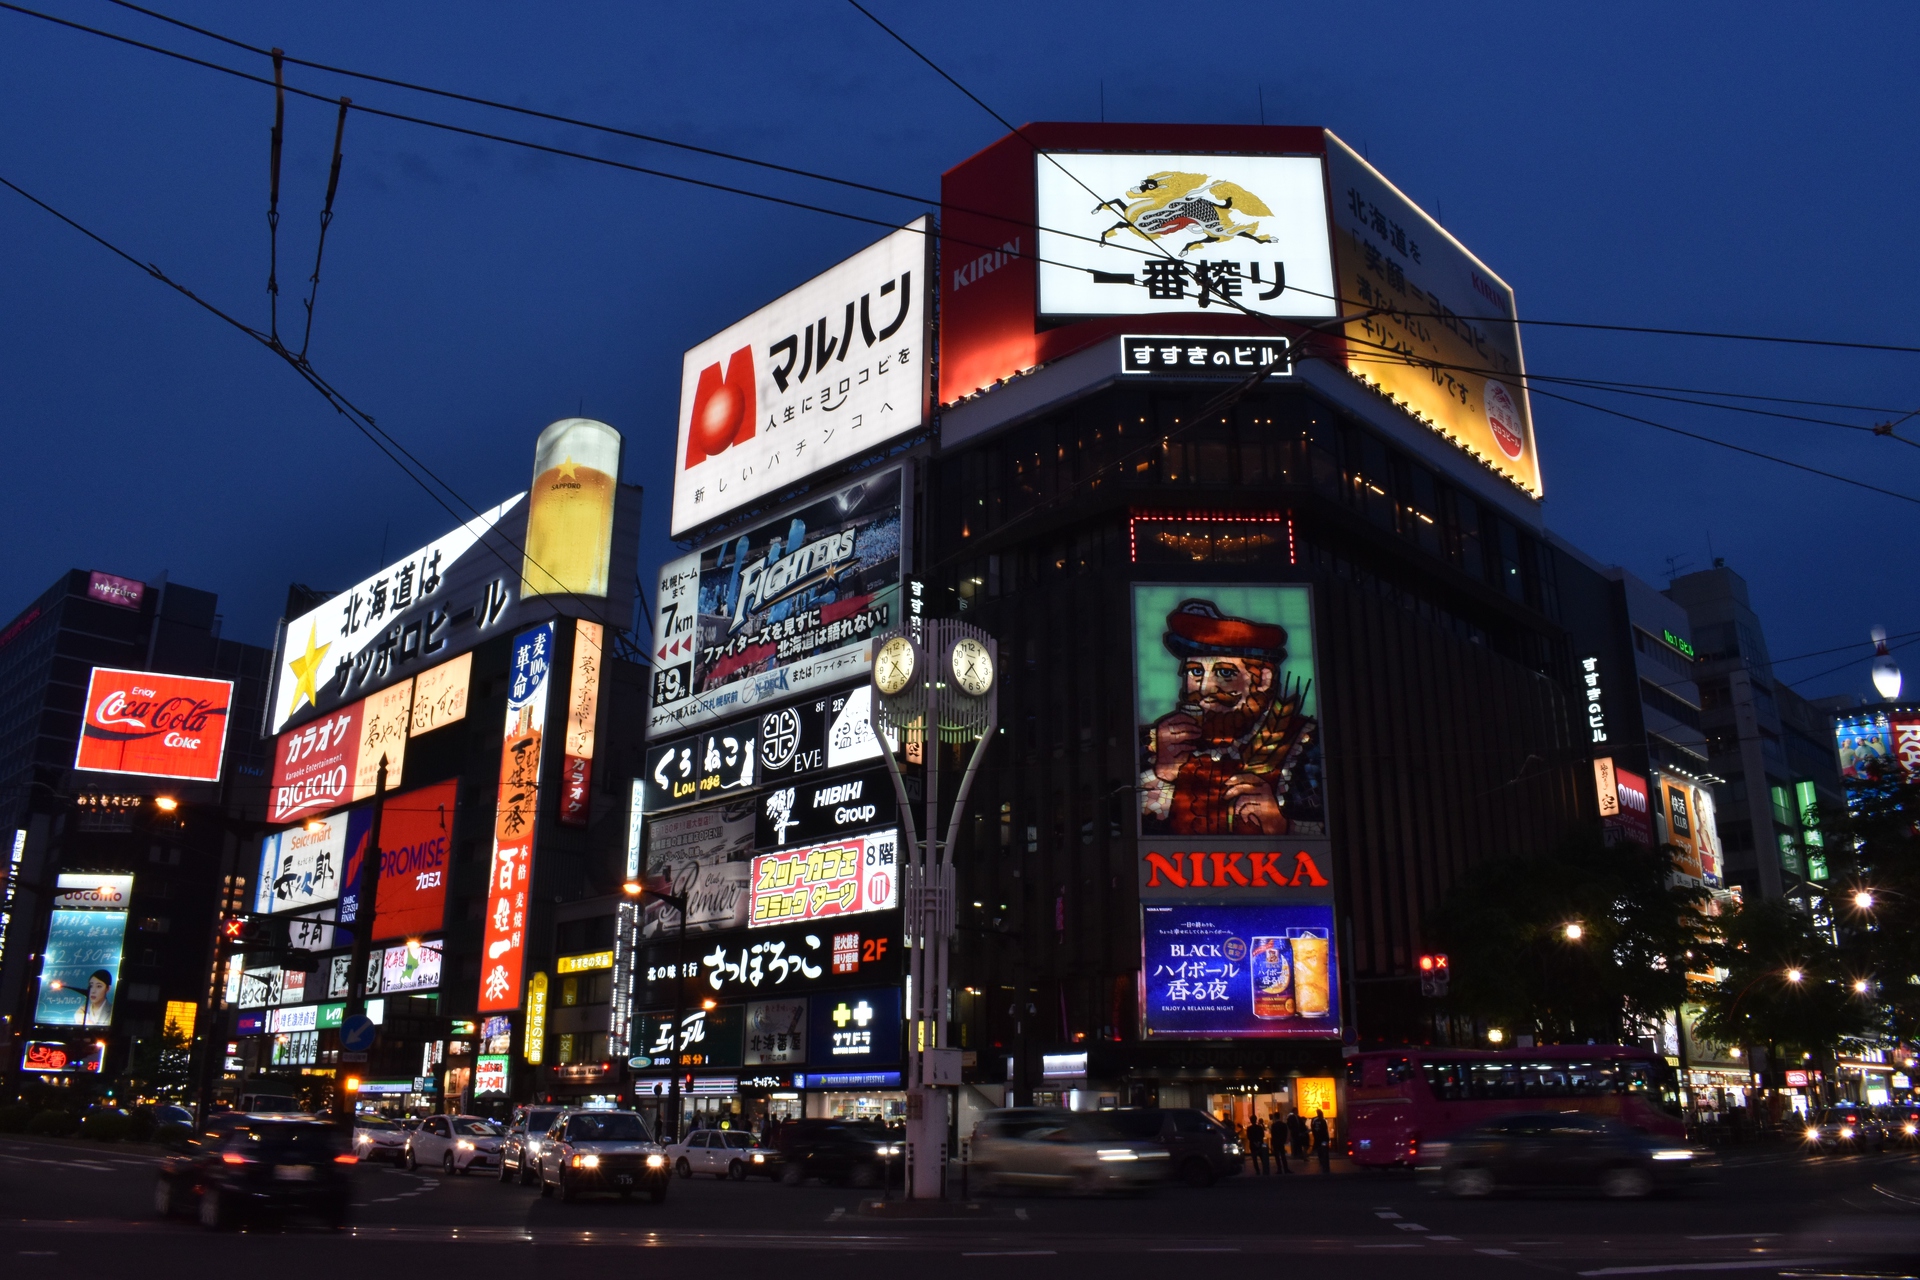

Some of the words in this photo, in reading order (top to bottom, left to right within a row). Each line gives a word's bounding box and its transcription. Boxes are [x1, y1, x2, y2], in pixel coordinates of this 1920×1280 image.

[1347, 186, 1421, 266] 北海道を
[953, 236, 1021, 292] KIRIN
[1092, 259, 1286, 301] 一番搾り
[1471, 270, 1507, 314] KIRIN
[769, 270, 911, 394] マルハン
[1132, 346, 1279, 366] すすきのビル
[765, 347, 911, 432] 人生にヨロコビを
[551, 482, 582, 491] SAPPORO
[94, 581, 138, 600] Mercure
[340, 548, 443, 639] 北海道は
[661, 567, 698, 592] 札幌ドーム
[672, 586, 686, 600] まで
[728, 526, 858, 638] FIGHTERS
[335, 578, 511, 698] サッポロビール
[662, 602, 694, 639] 7km
[703, 608, 821, 665] ファイターズを見ずに
[776, 606, 888, 661] 北海道は語れない！
[513, 644, 532, 699] 革命
[656, 672, 666, 705] 地下鉄
[793, 665, 812, 683] または
[131, 686, 157, 699] Enjoy
[815, 701, 826, 713] 8F
[832, 698, 845, 713] 2F
[1582, 656, 1608, 743] すすきのビル
[96, 690, 214, 732] Coca-Cola
[164, 732, 202, 750] Coke
[285, 714, 352, 766] カラオケ
[285, 765, 305, 781] Karaoke
[306, 753, 343, 775] Entertainment
[654, 736, 738, 790] くろねこ
[794, 748, 823, 774] EVE
[275, 783, 305, 819] BIG
[306, 764, 348, 801] ECHO
[567, 757, 587, 813] カラオケ
[674, 774, 721, 798] Lounge
[813, 780, 863, 808] HIBIKI
[766, 787, 800, 845] 響
[834, 803, 876, 825] Group
[1670, 794, 1686, 815] 快活
[1674, 814, 1688, 830] CLUB
[379, 837, 446, 880] PROMISE
[757, 848, 860, 891] ネットカフェ
[866, 843, 895, 867] 8階
[1143, 850, 1330, 889] NIKKA
[273, 848, 335, 901] 長次郎
[415, 870, 441, 891] プロミス
[661, 861, 741, 920] Pemier
[754, 888, 809, 920] コミック
[811, 882, 857, 913] ダーツ
[298, 912, 323, 947] 牛角
[485, 847, 519, 1002] 百姓一揆
[570, 954, 609, 969] すすきの交番
[647, 962, 698, 981] 北の味行
[703, 935, 823, 991] さっぽろっこ
[862, 937, 888, 963] 2F
[1170, 944, 1222, 957] BLACK
[382, 976, 391, 992] 1F
[1153, 960, 1240, 979] ハイボール
[1166, 978, 1229, 1001] 香る夜
[529, 991, 546, 1063] すすきの交番
[750, 1031, 802, 1053] 北海番屋
[832, 1031, 871, 1047] サツドラ
[849, 1075, 863, 1084] HAPPY
[863, 1074, 885, 1084] LIFESTYLE
